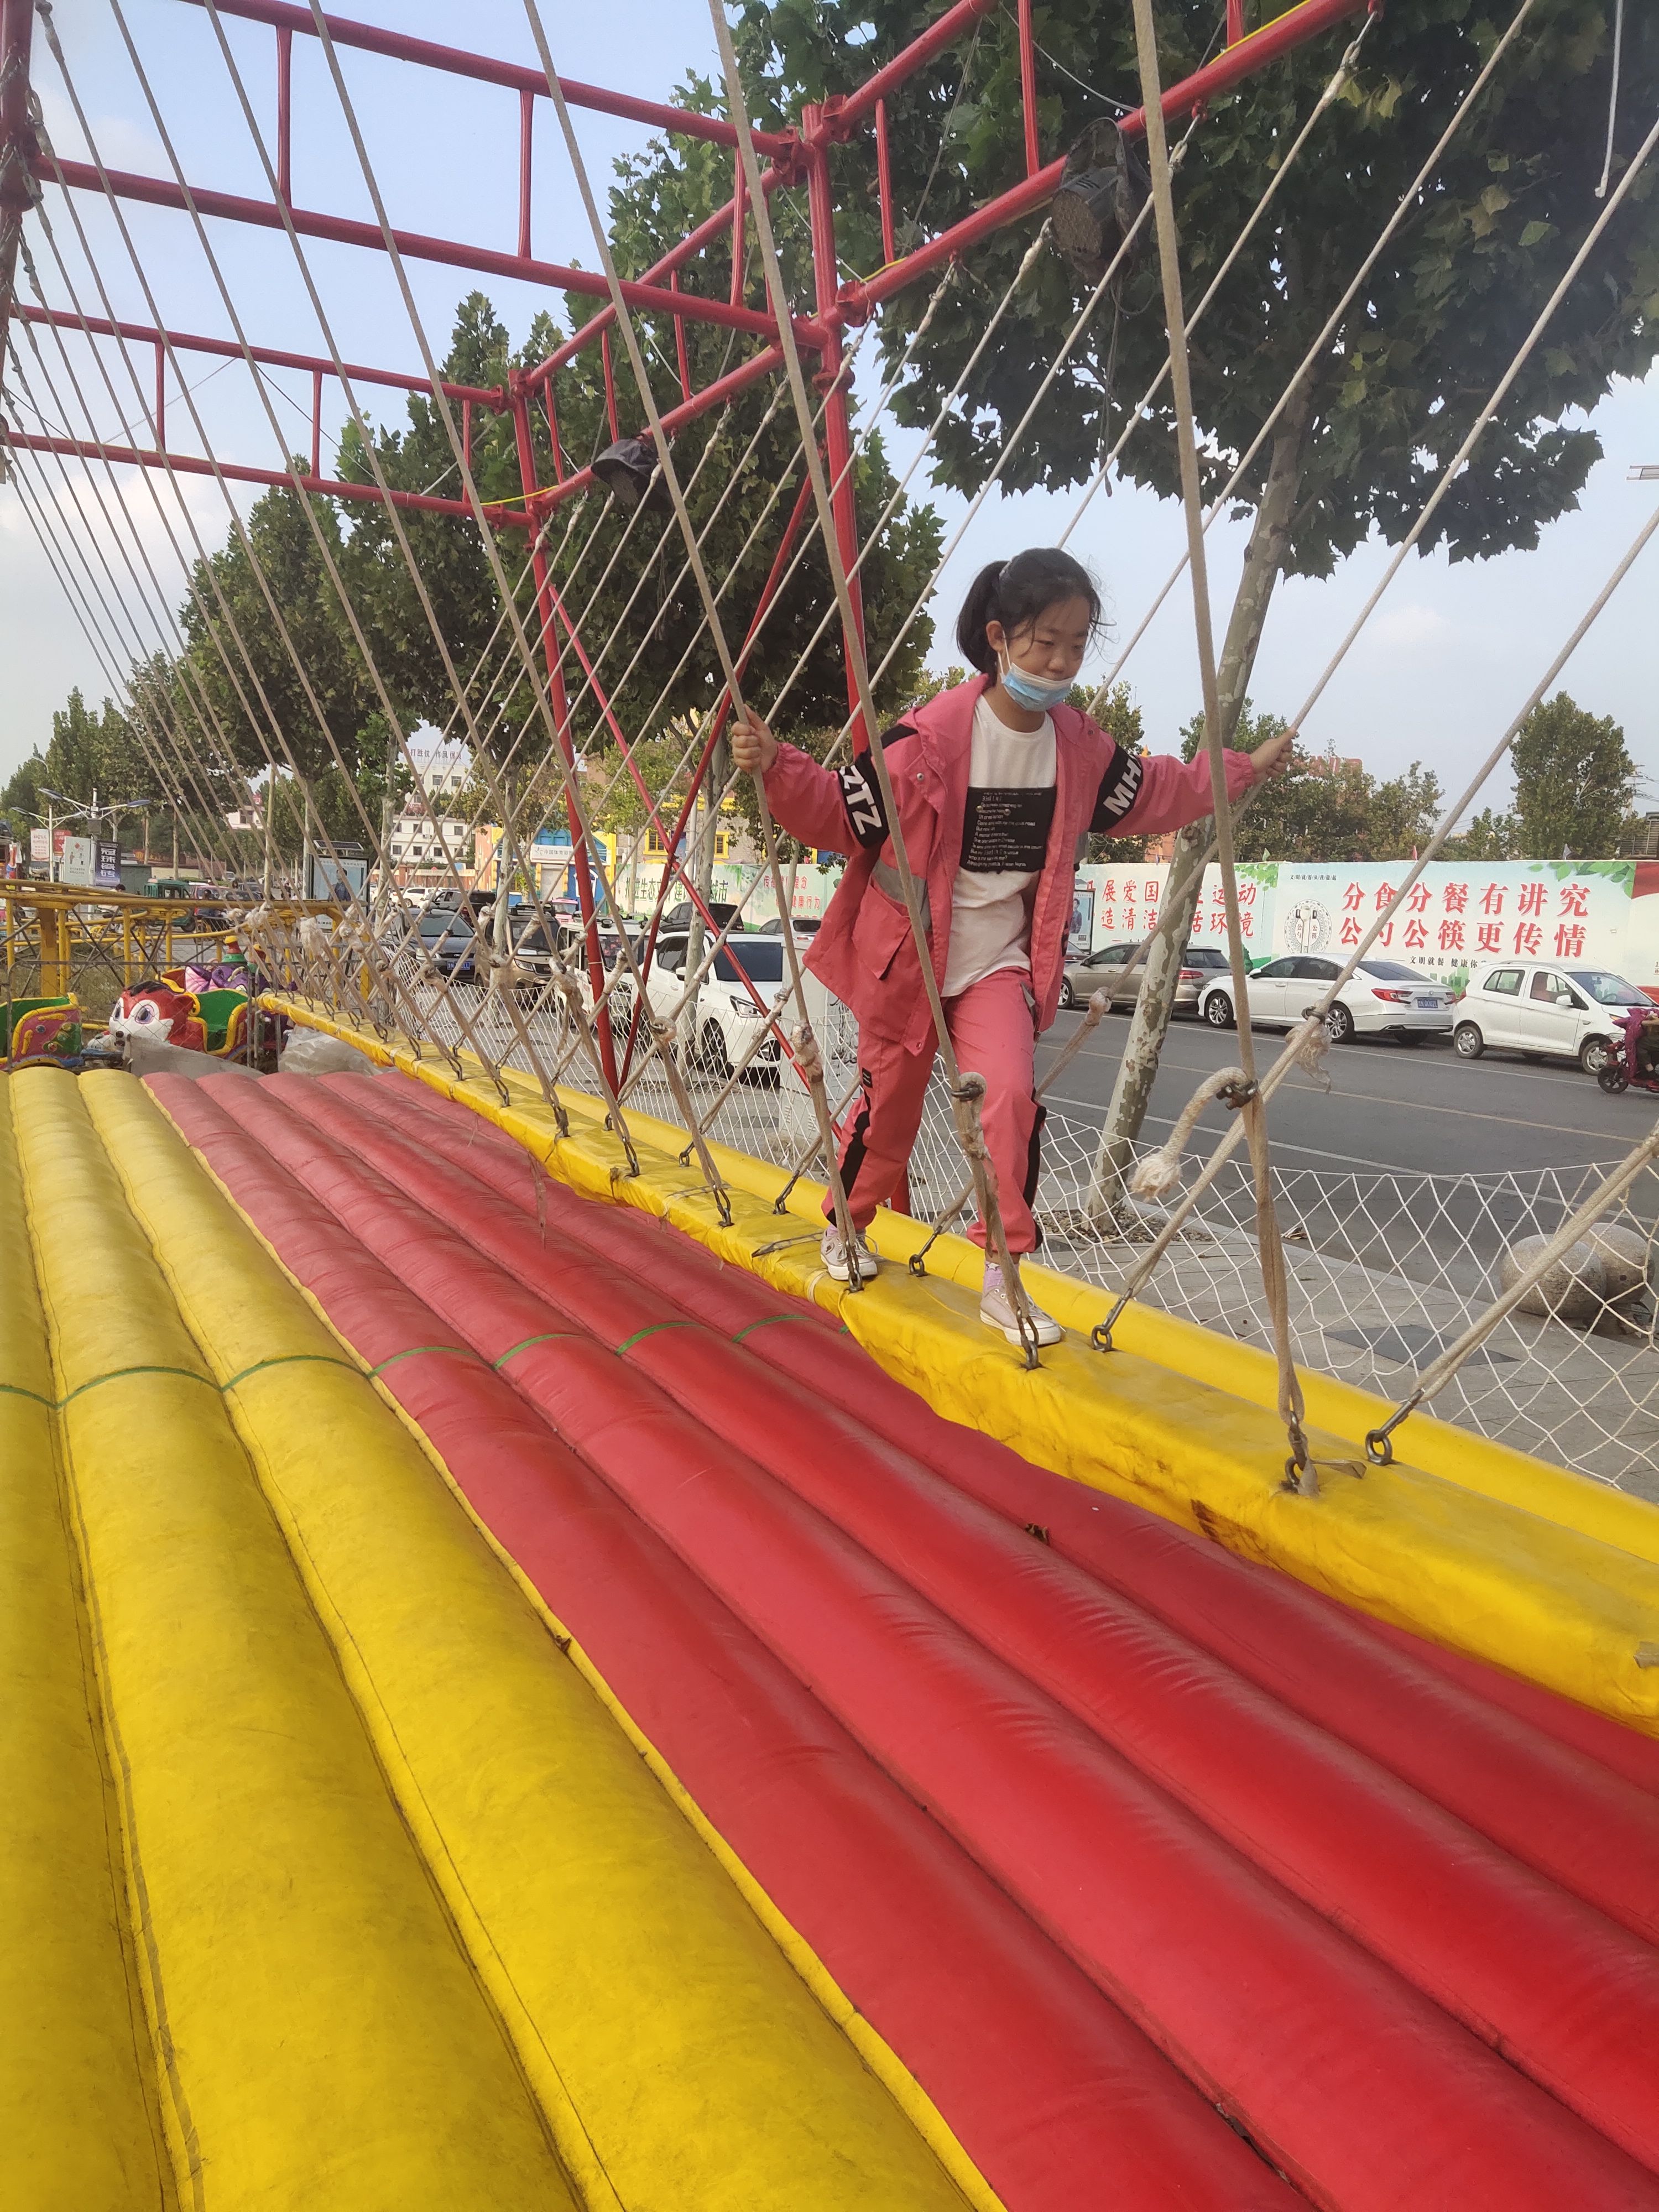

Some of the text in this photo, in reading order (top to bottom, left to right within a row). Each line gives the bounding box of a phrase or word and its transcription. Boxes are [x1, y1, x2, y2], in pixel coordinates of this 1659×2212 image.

[1103, 754, 1141, 816] MH
[1087, 879, 1256, 906] 展爱国运动
[1342, 881, 1590, 917] 分食分餐有讲究
[1093, 907, 1254, 937] 造清洁活环境
[1339, 916, 1587, 958] 公勺公筷更传情
[1409, 956, 1444, 967] 文明就餐
